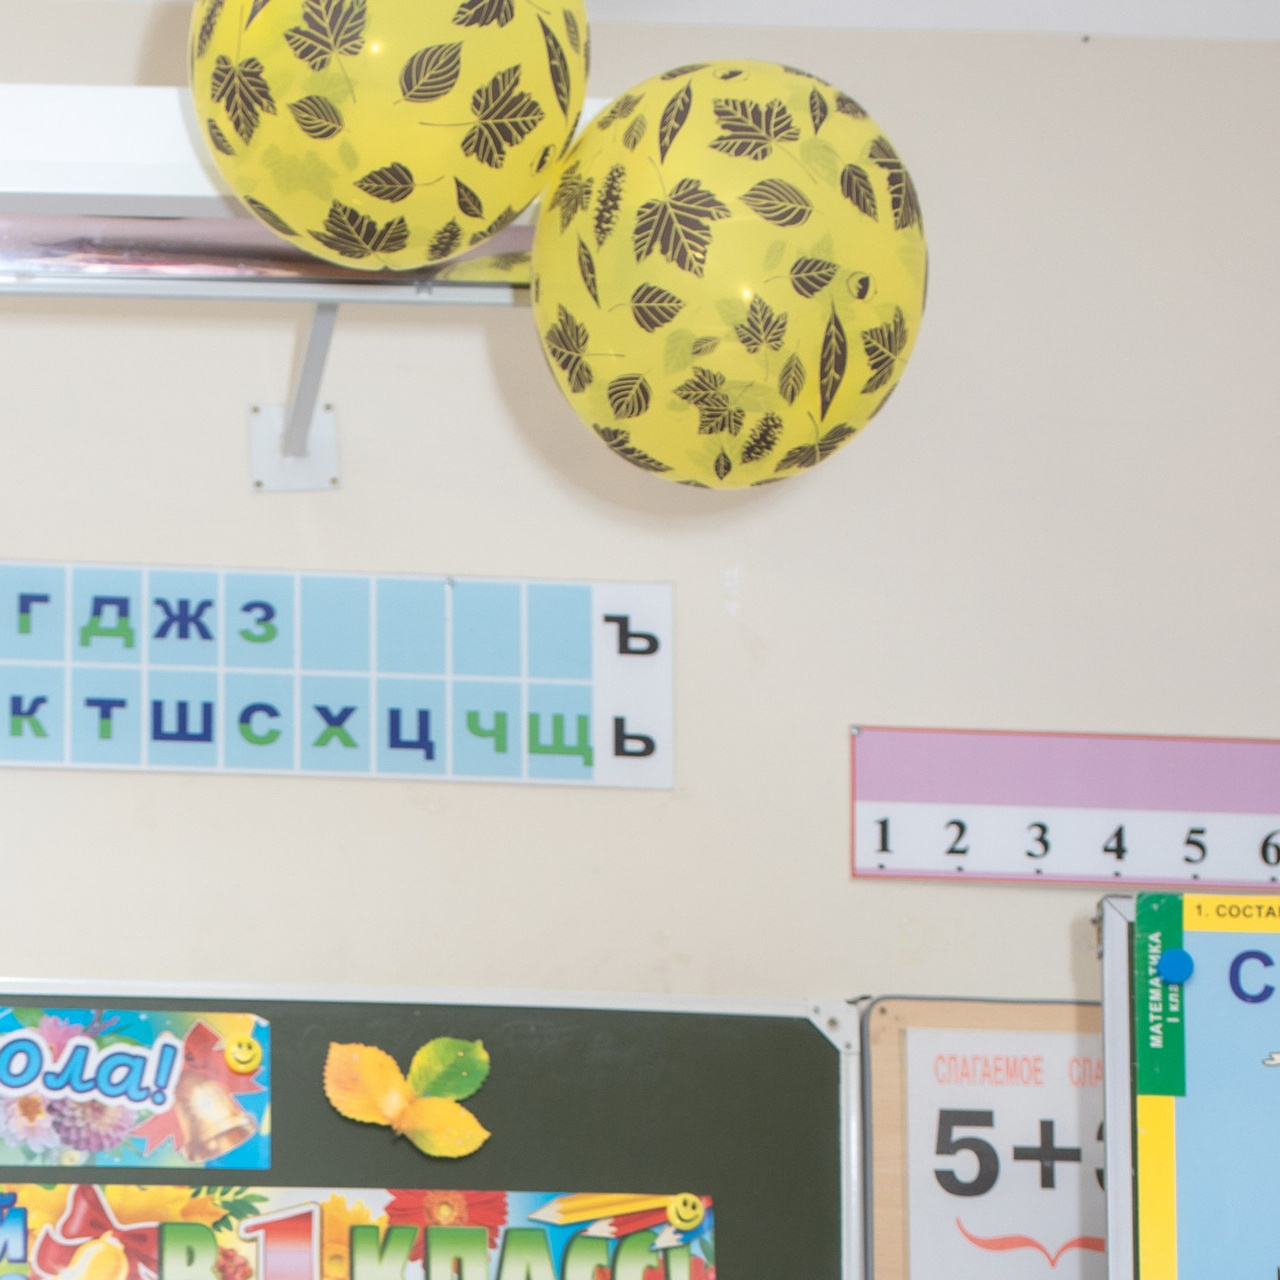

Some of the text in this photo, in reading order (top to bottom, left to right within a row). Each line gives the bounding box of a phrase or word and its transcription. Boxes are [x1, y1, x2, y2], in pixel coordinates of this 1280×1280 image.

[17, 594, 50, 634] г
[81, 597, 134, 648] д
[153, 599, 214, 640] ж
[240, 600, 277, 642] з
[605, 616, 660, 654] ъ
[11, 696, 49, 737] к
[85, 699, 127, 739] т
[151, 701, 214, 742] ш
[239, 703, 281, 746] с
[313, 706, 358, 747] х
[388, 709, 435, 760] ц
[467, 711, 507, 752] ч
[528, 713, 594, 766] щ
[614, 718, 655, 757] ь
[875, 818, 1280, 866] 1 2 3 4 5 6
[1196, 903, 1280, 918] 1. СОСТА
[934, 1054, 1044, 1086] СЛАГАЕМОЕ
